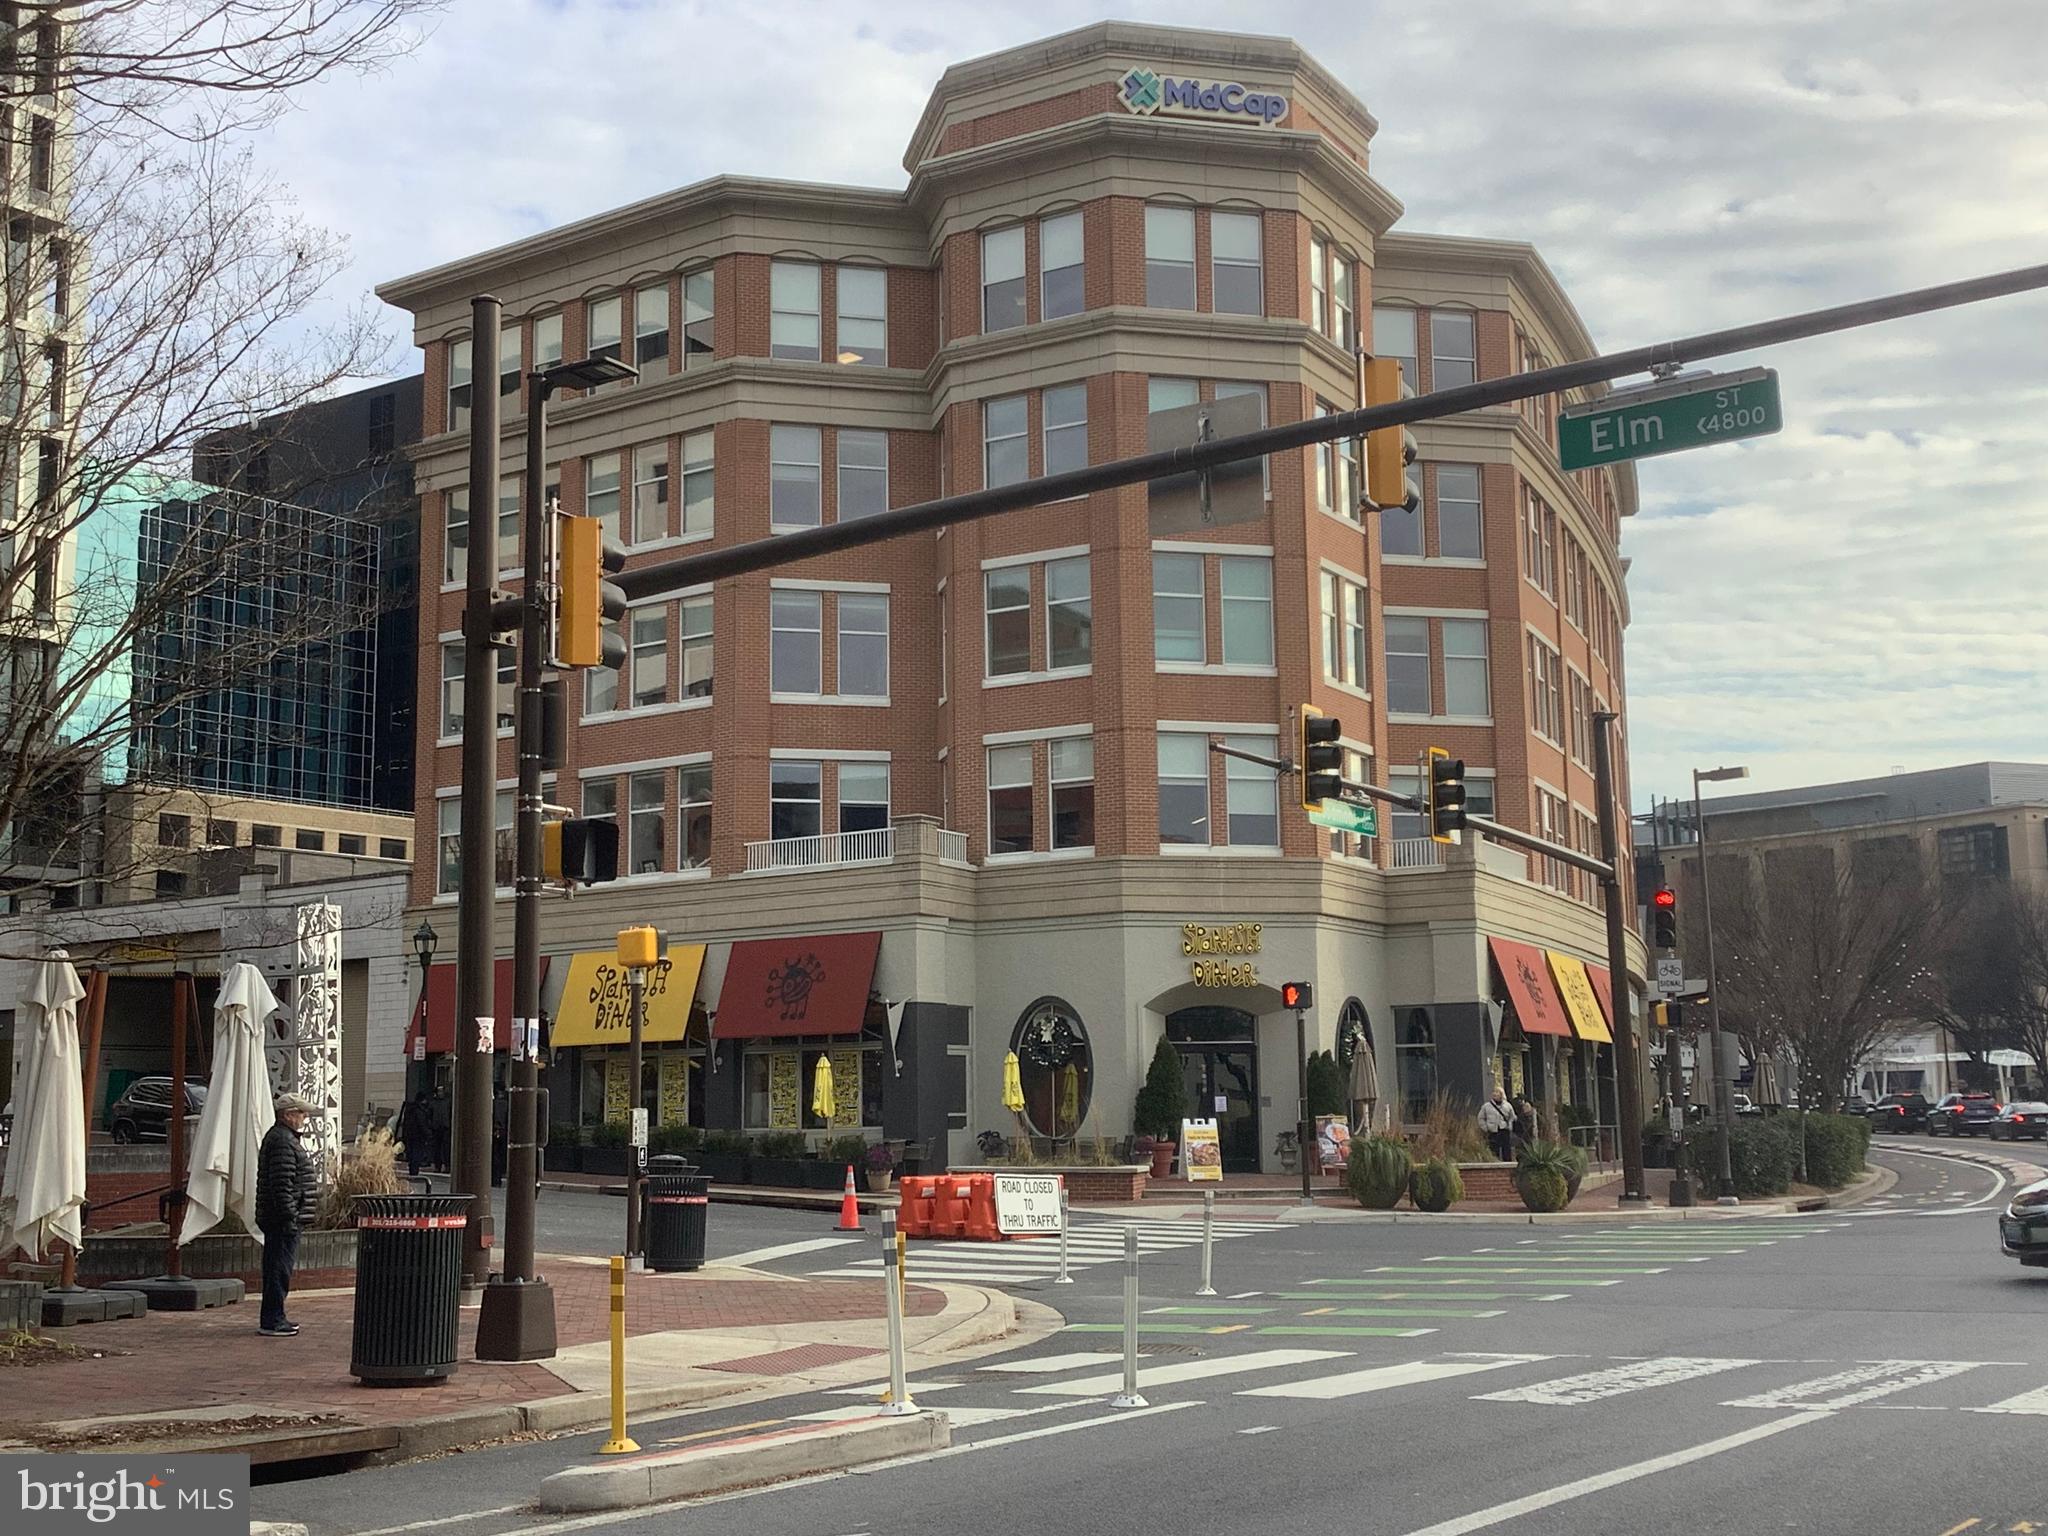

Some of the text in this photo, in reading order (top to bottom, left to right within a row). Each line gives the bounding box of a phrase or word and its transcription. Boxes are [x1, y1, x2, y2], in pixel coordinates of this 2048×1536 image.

[1164, 78, 1287, 122] MidCap
[1716, 388, 1741, 408] ST
[1590, 415, 1664, 453] Elm
[1001, 1180, 1054, 1194] ROAD CLOSED
[1024, 1198, 1034, 1211] TO
[1003, 1214, 1058, 1227] THRU TRAFFIC
